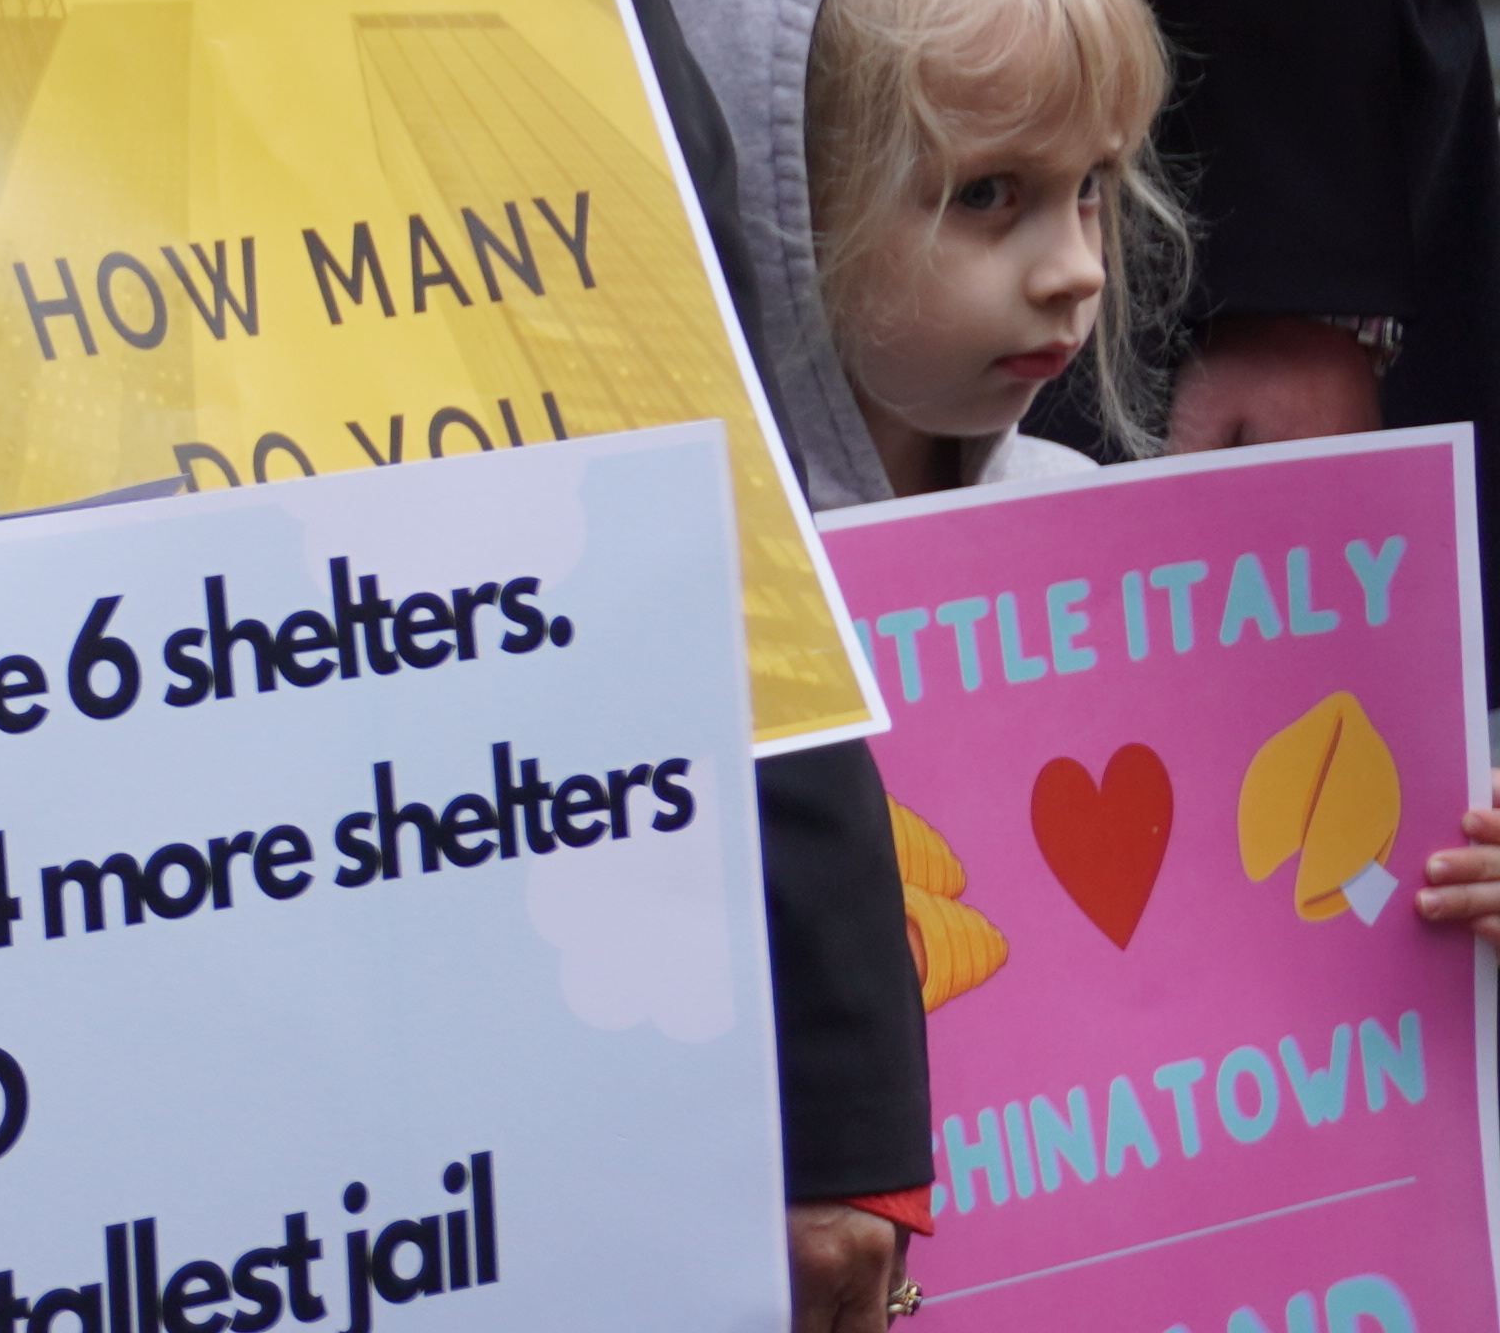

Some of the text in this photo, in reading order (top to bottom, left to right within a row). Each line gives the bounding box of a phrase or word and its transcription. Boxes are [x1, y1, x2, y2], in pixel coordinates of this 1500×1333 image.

[12, 191, 599, 362] HOW MANY
[65, 594, 143, 721] 6
[161, 555, 576, 709] shelters.
[853, 535, 1407, 703] TTLE ITALY
[39, 809, 315, 942] more
[329, 742, 698, 893] shelters
[933, 1010, 1428, 1217] HINATOWN
[338, 1150, 500, 1333] jail
